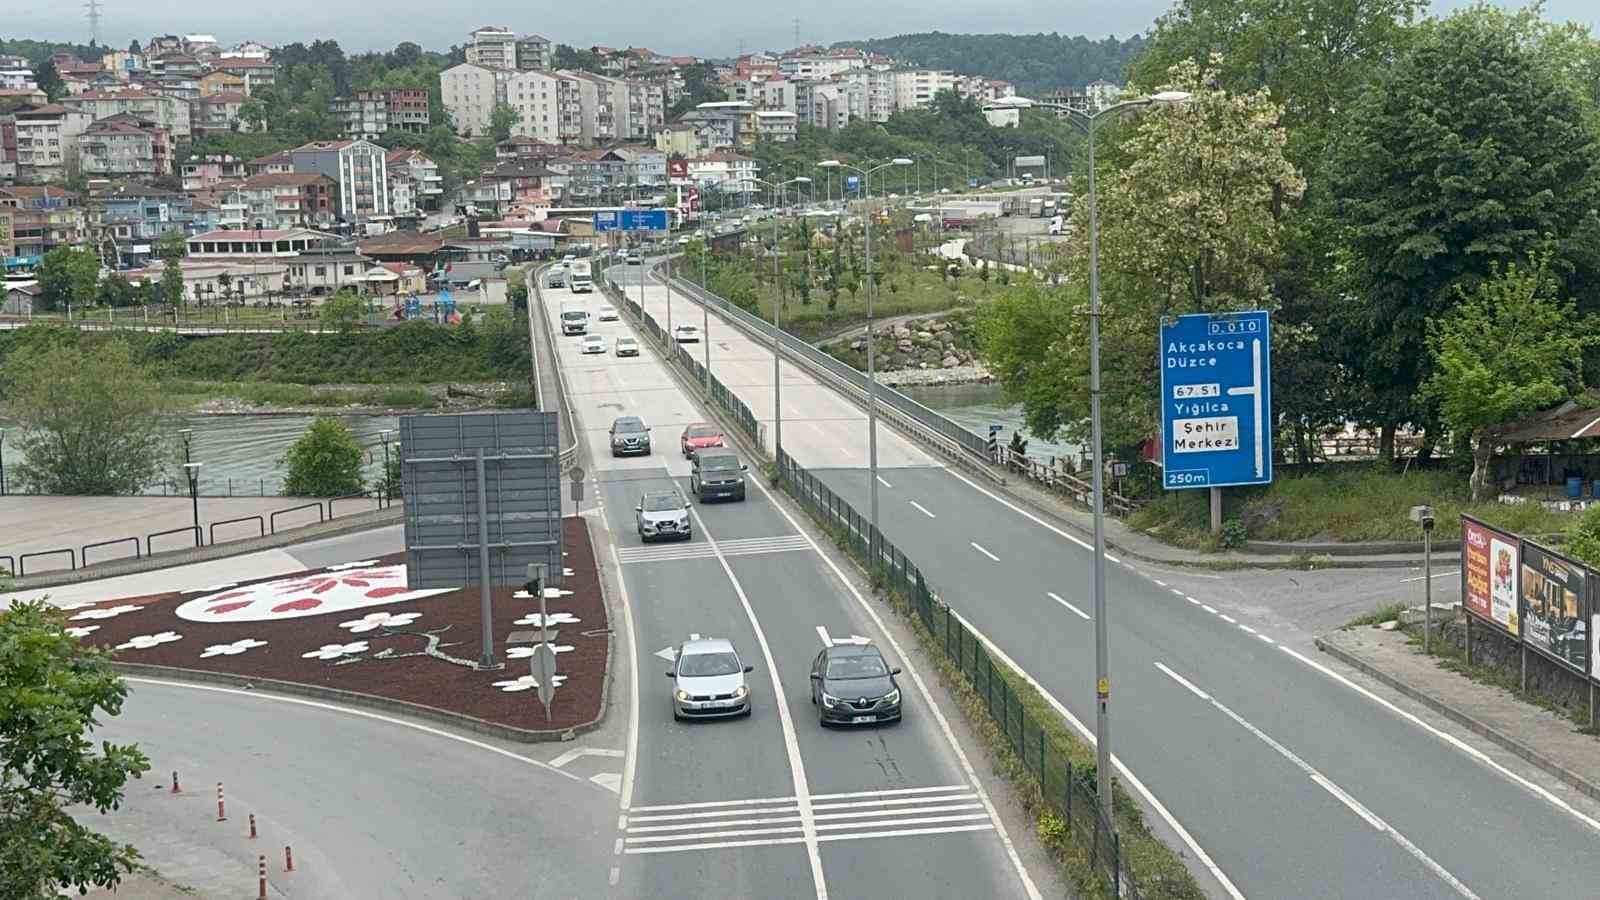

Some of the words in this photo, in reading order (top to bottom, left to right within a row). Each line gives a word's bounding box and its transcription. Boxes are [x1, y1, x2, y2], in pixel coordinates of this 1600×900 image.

[1212, 322, 1257, 334] D.010
[1167, 341, 1245, 354] Akçakoca
[1167, 357, 1217, 369] Düzce
[1174, 402, 1229, 415] Yığılca
[1184, 421, 1227, 434] Şehir
[1175, 436, 1238, 449] Merkezi
[1169, 472, 1206, 484] 250m
